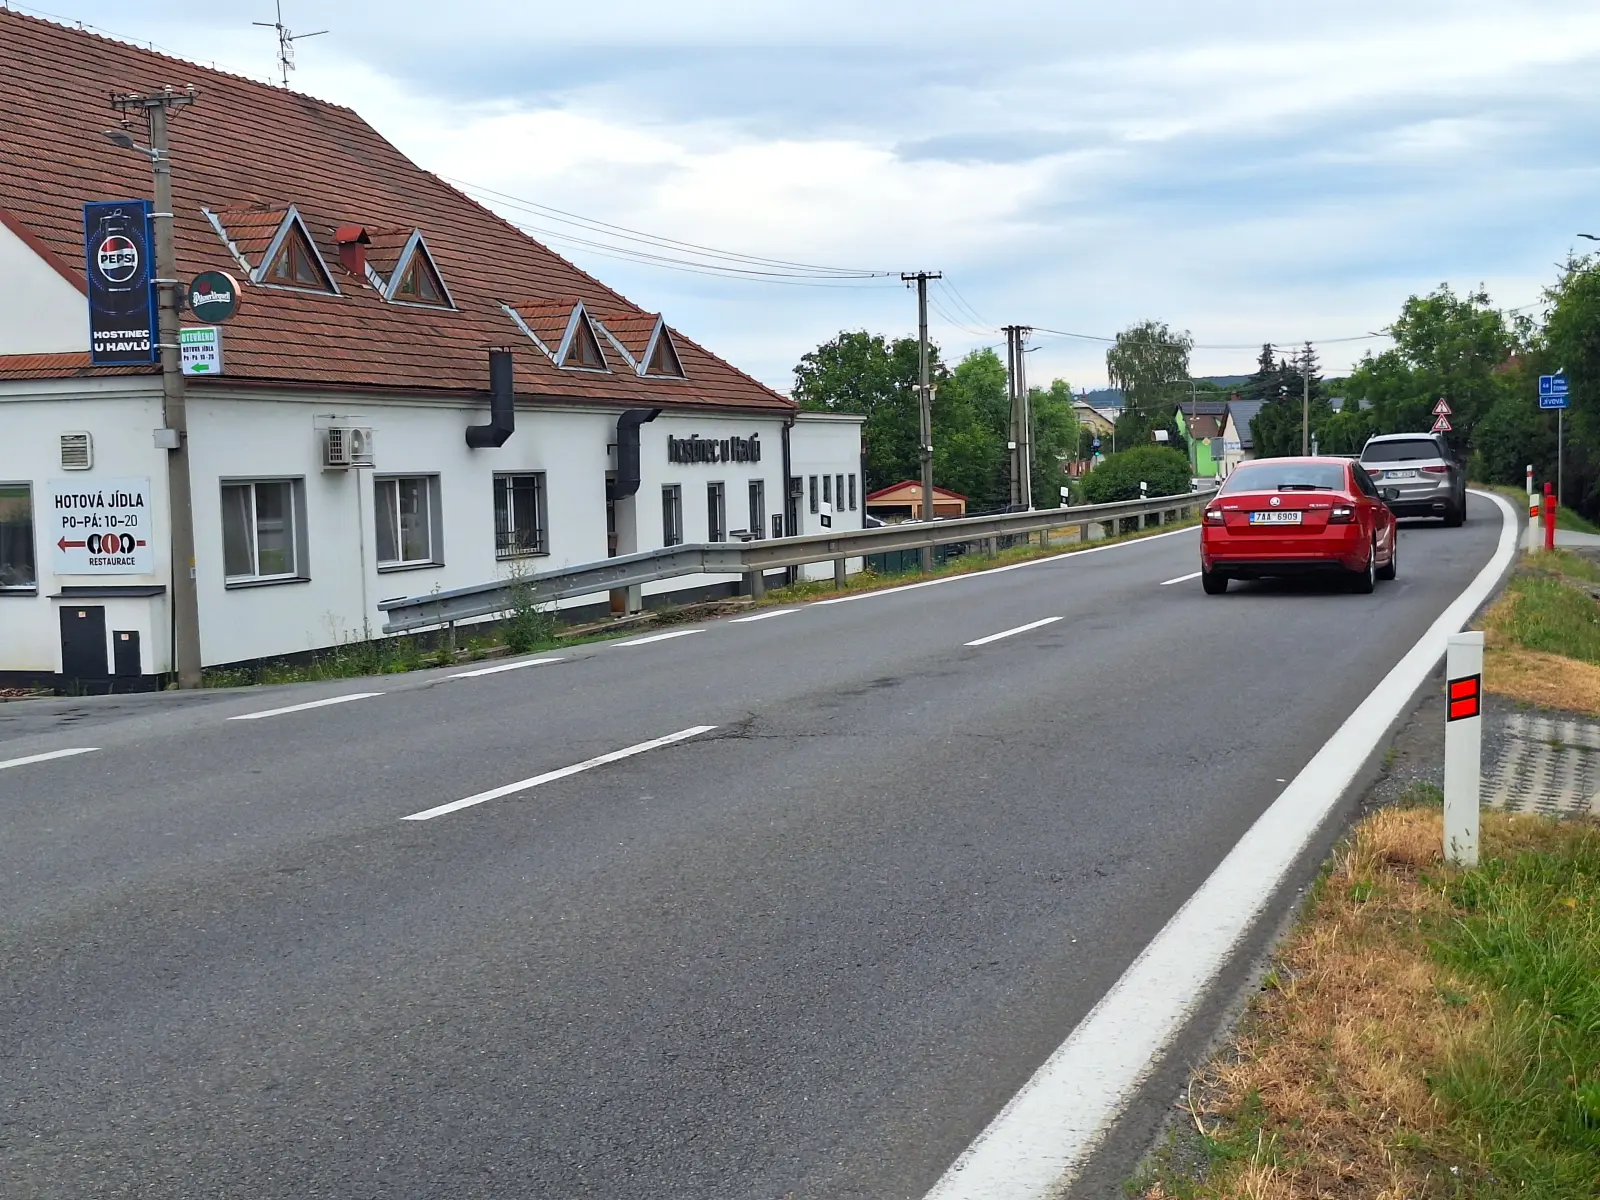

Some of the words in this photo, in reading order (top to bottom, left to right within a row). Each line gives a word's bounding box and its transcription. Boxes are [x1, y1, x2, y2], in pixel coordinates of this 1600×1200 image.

[100, 254, 135, 264] PEPSI
[93, 329, 150, 339] HOSTINEC
[181, 331, 214, 343] OTEVŘENO
[94, 342, 104, 352] U
[106, 339, 151, 352] HAVLŮ
[55, 490, 105, 509] HOTOVÁ
[108, 490, 144, 508] JÍDLA
[105, 514, 138, 528] 10-20
[1256, 512, 1271, 521] 7AA
[1277, 512, 1298, 521] 6909
[89, 557, 136, 566] RESTAURACE
